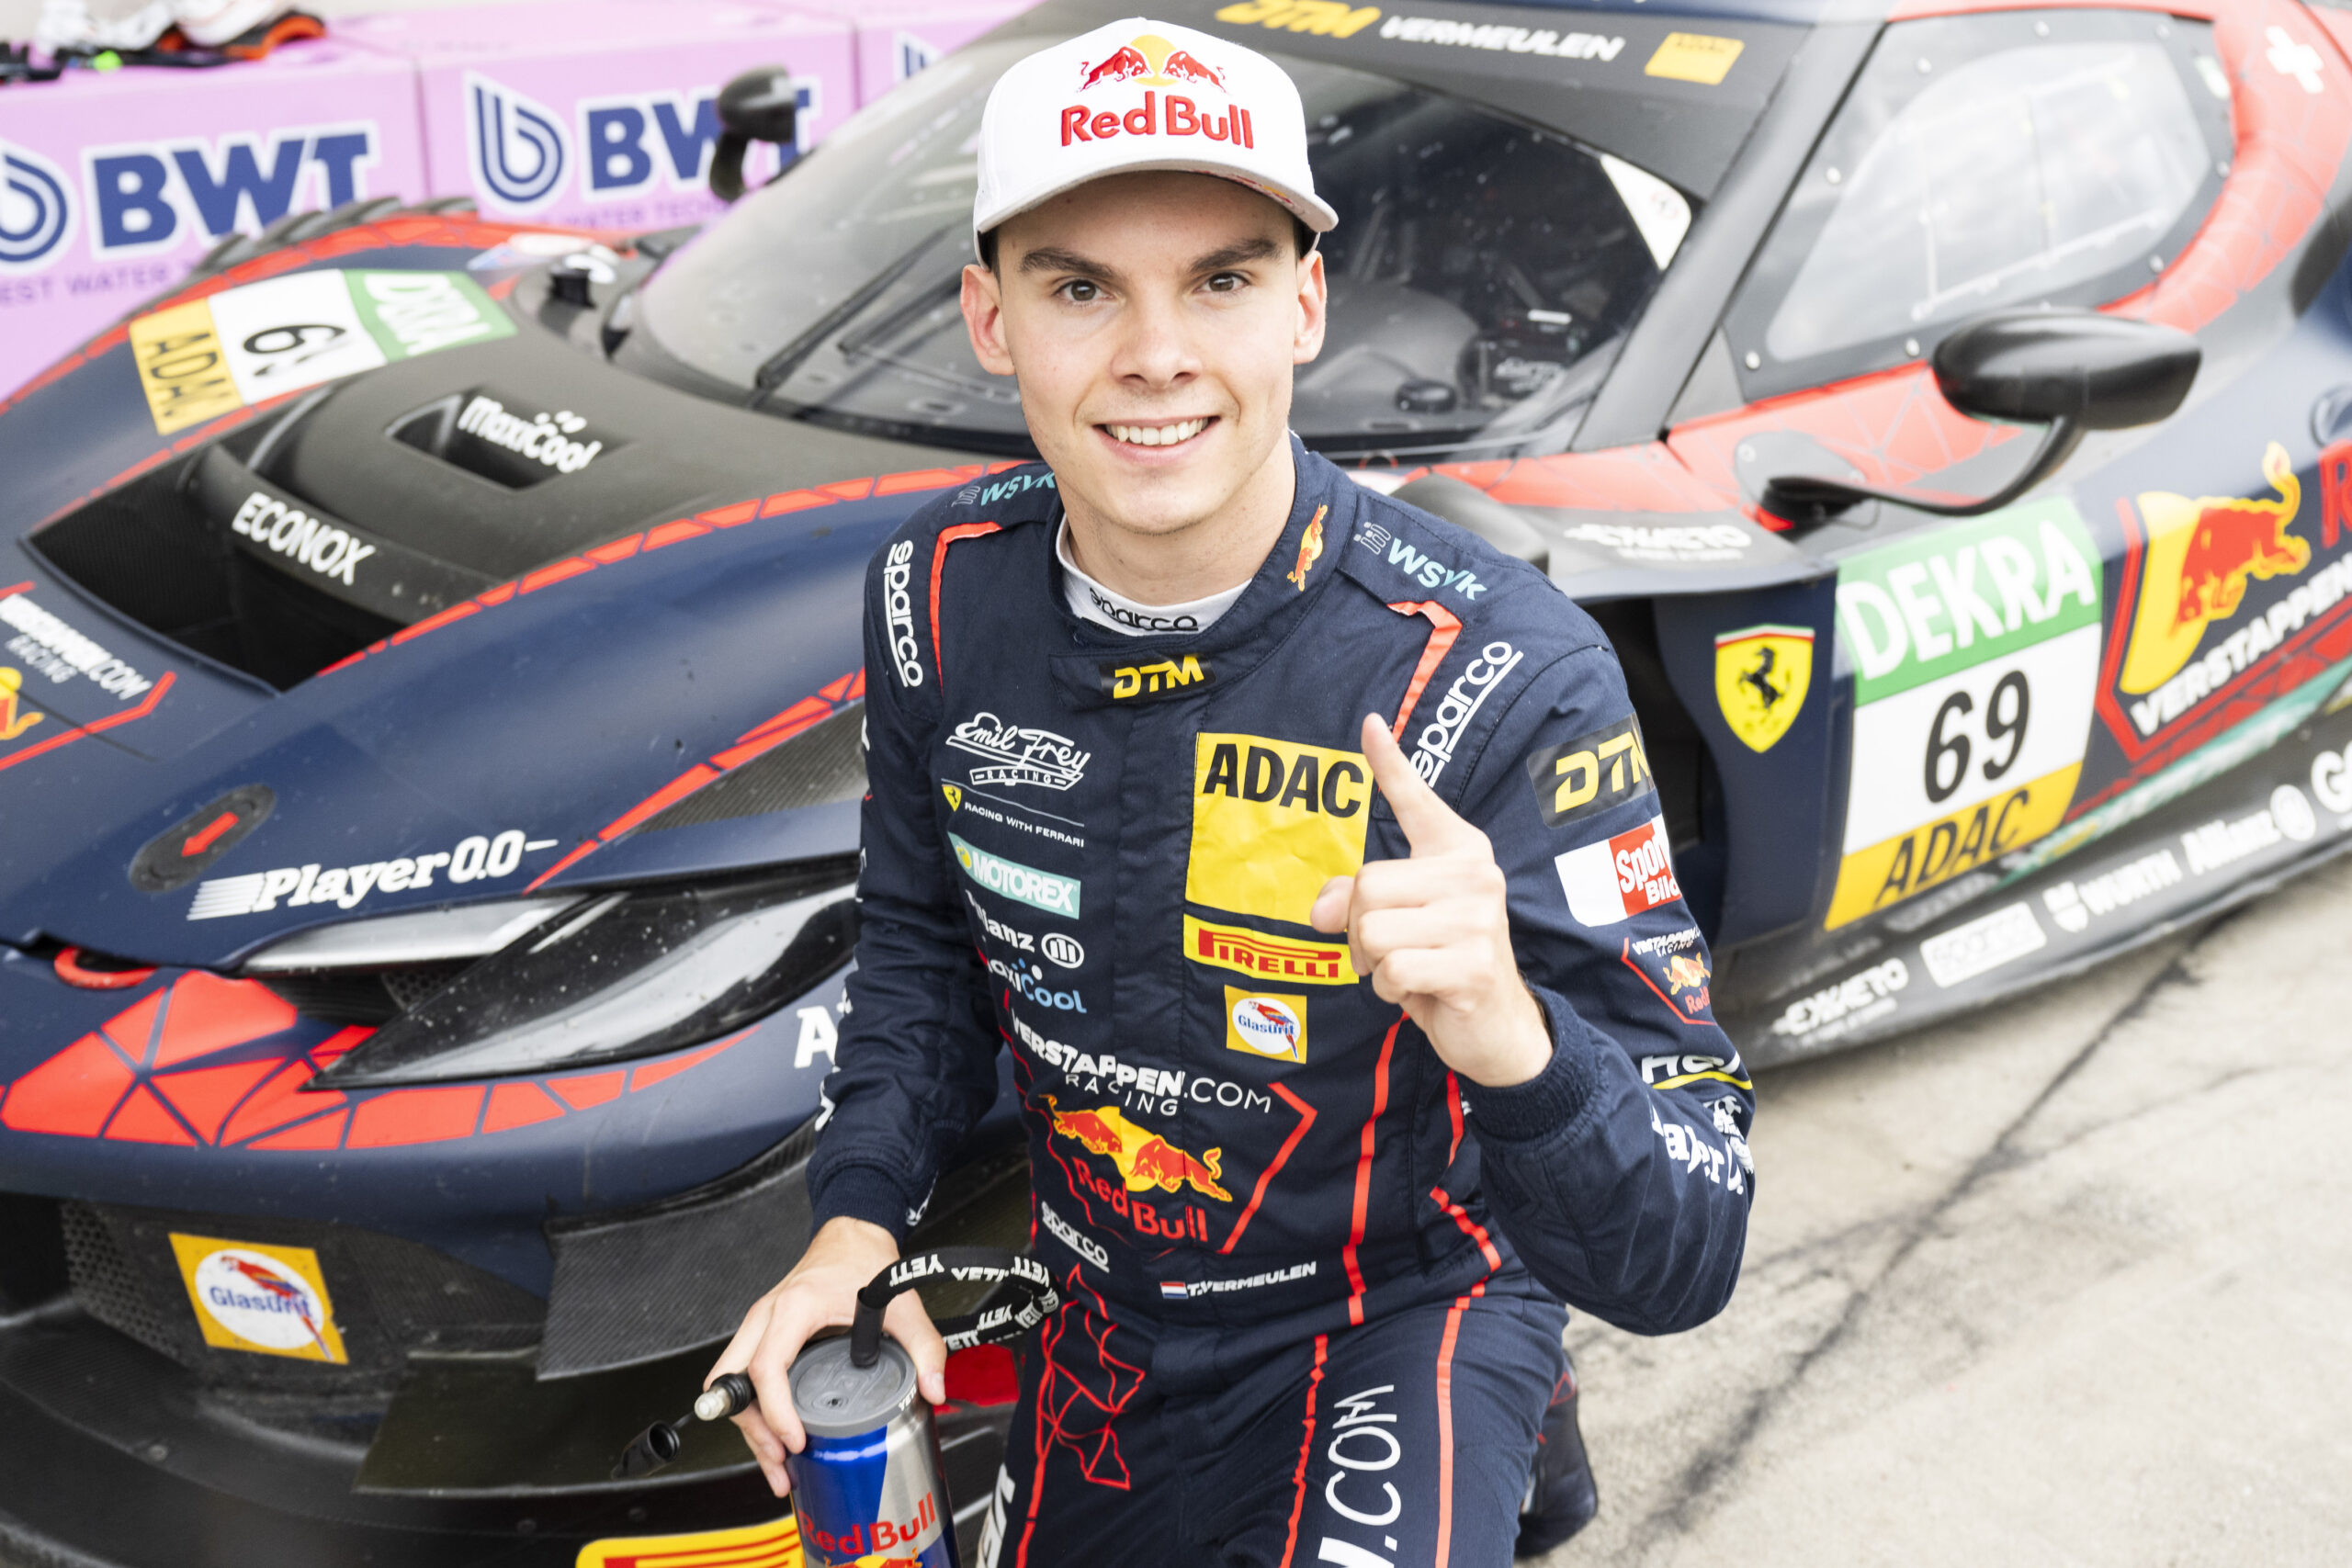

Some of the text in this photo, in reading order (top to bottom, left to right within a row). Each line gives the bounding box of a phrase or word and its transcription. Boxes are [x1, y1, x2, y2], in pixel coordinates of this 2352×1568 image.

[1379, 16, 1625, 62] VERMEULEN
[1061, 90, 1254, 150] Red Bull
[93, 133, 369, 249] BWT
[232, 491, 375, 585] ECONOX
[884, 539, 923, 688] sparco
[1836, 520, 2098, 681] DEKRA
[1113, 653, 1204, 699] DTM
[1409, 641, 1524, 788] sparco
[1923, 671, 2030, 804] 69
[987, 769, 1052, 784] RACING
[1018, 728, 1091, 778] Frey
[1203, 742, 1365, 818] ADAC
[965, 801, 1085, 848] RACING WITH FERRARI
[1872, 789, 2030, 908] ADAC
[255, 850, 450, 911] Player
[970, 851, 1074, 913] MOTOREX
[1198, 928, 1342, 978] PIRELLI
[1012, 1008, 1273, 1113] VERSTAPPEN.COM
[1065, 1074, 1180, 1116] RACING
[1072, 1156, 1209, 1243] Red Bull
[1042, 1201, 1110, 1273] sparco
[889, 1253, 945, 1288] YETI
[797, 1507, 865, 1555] Red
[869, 1491, 937, 1553] Bull
